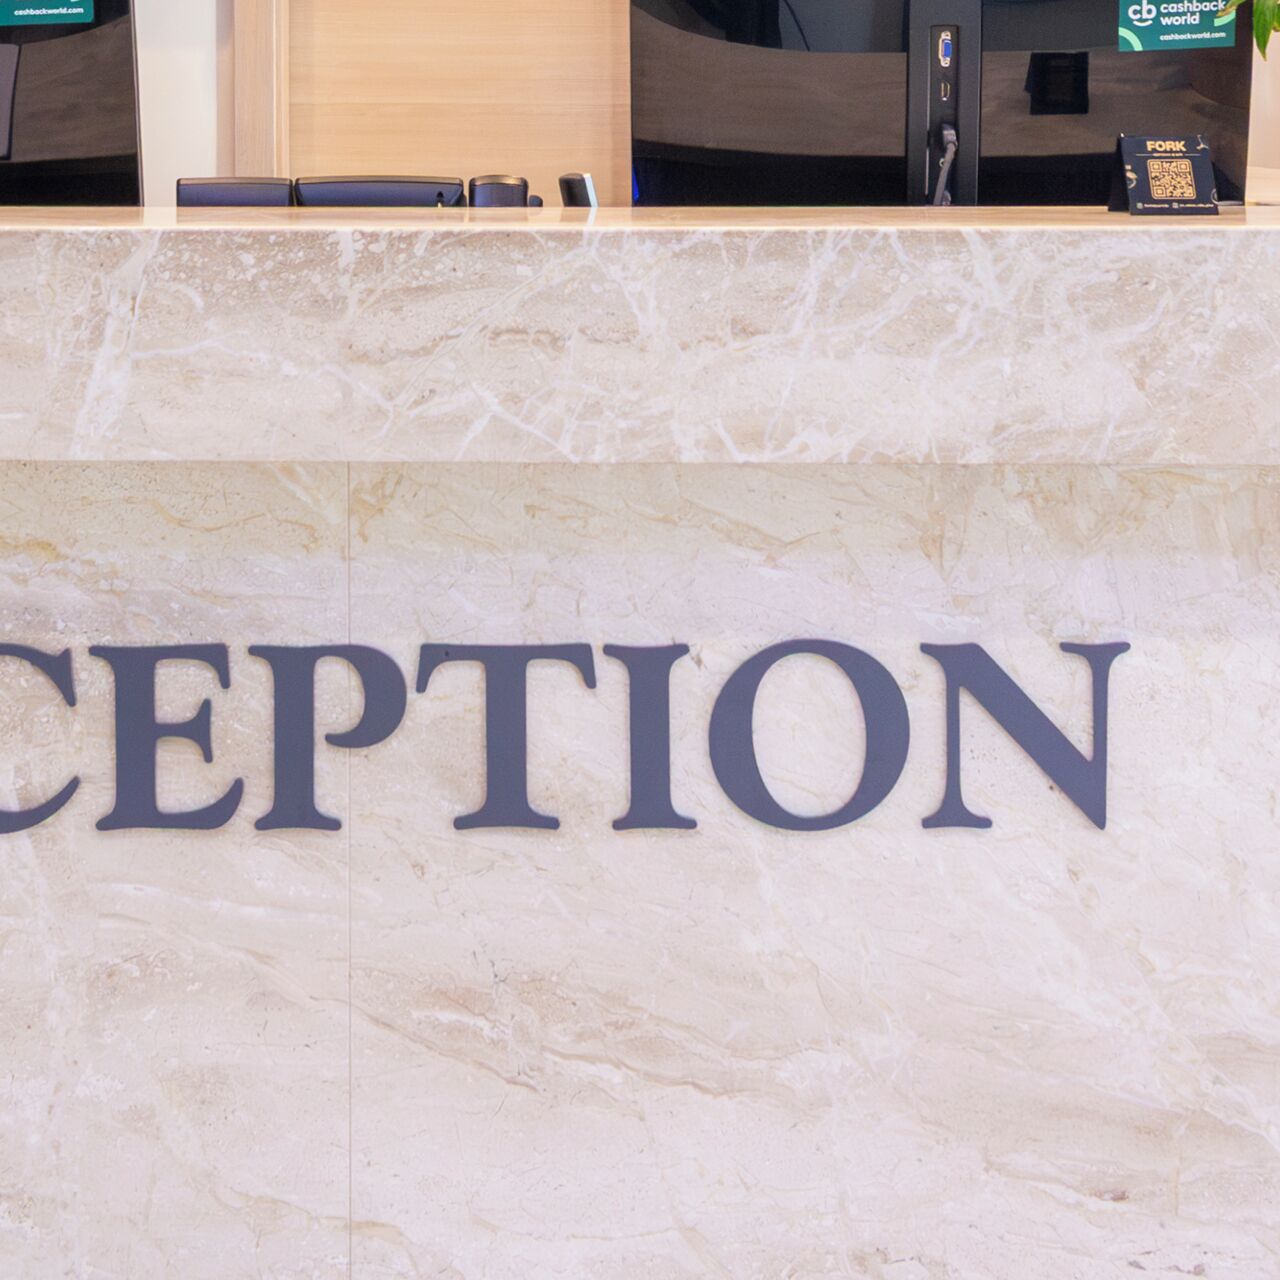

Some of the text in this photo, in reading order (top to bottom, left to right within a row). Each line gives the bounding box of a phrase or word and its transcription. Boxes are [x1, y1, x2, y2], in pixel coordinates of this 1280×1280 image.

[14, 7, 84, 16] cashbackworld.com
[1128, 0, 1157, 20] cb
[1160, 12, 1200, 26] world
[1160, 31, 1226, 40] cashbackworld.com
[1146, 141, 1187, 151] FORK
